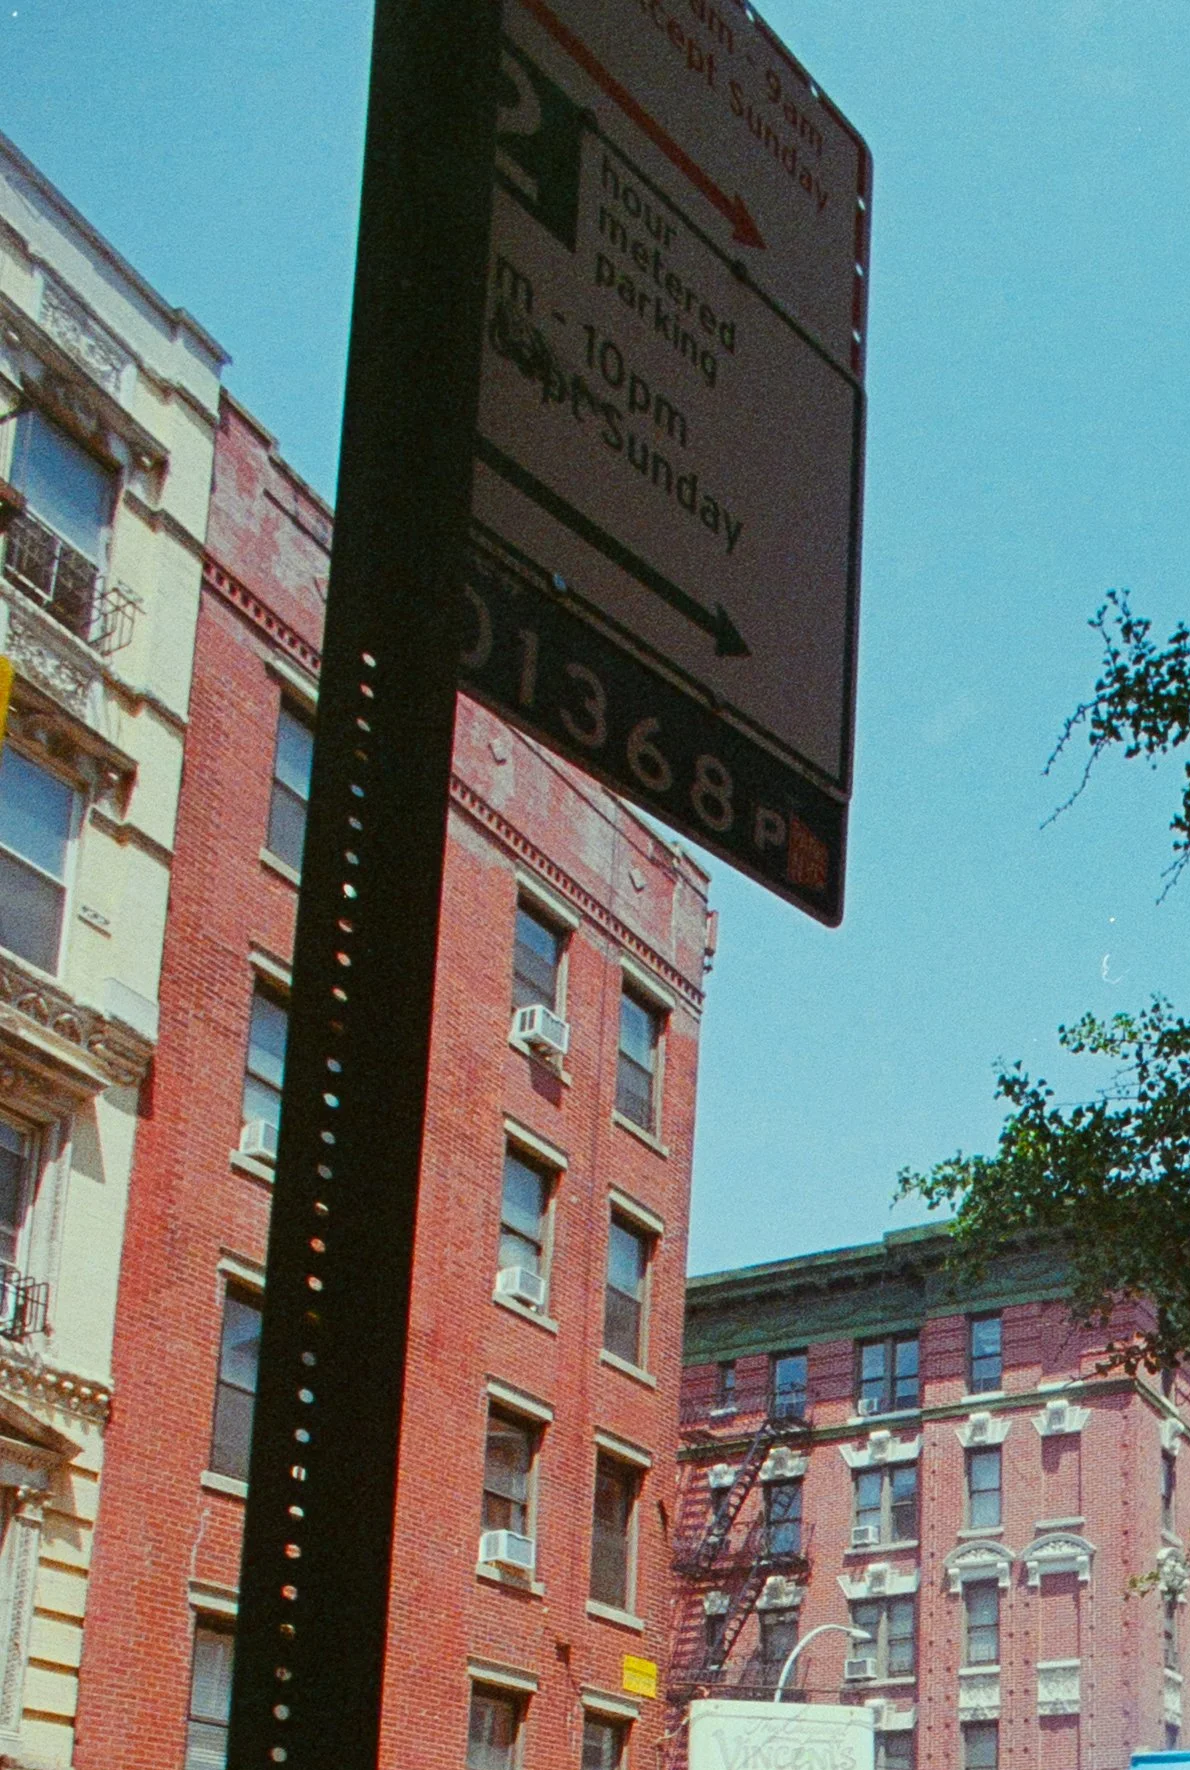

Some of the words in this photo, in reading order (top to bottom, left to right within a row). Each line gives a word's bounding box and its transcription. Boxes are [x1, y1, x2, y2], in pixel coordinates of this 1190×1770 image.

[601, 154, 677, 249] hour
[729, 79, 829, 213] Sunday
[595, 252, 718, 388] parking
[599, 205, 736, 355] metered
[582, 323, 688, 448] 10pm
[600, 402, 742, 555] Sunday
